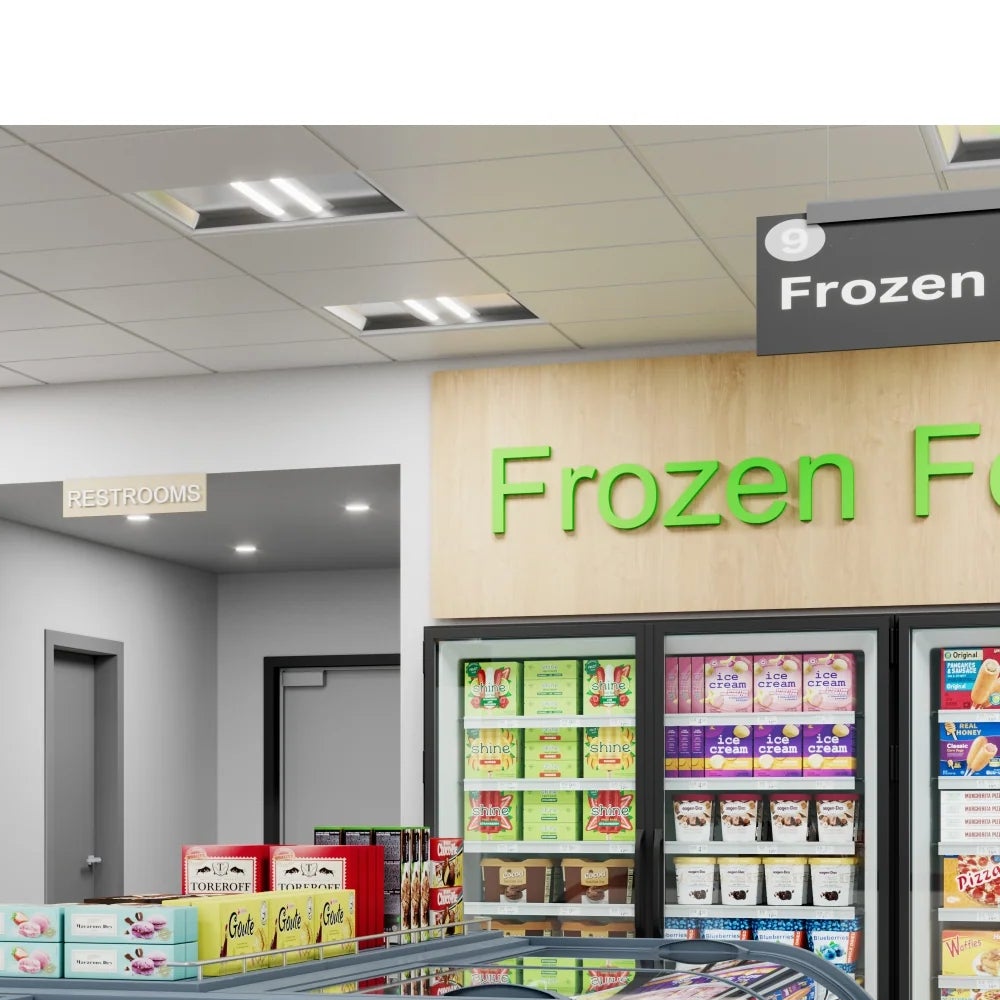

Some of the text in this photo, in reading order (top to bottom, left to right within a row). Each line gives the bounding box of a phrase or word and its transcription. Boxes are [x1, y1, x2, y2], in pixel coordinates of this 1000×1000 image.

[780, 226, 807, 254] 9
[780, 269, 985, 311] Frozen
[491, 422, 1000, 536] Frozen F
[67, 484, 201, 508] RESTROOMS
[716, 672, 739, 680] ice
[766, 672, 788, 680] ice
[815, 671, 838, 679] ice
[473, 682, 506, 693] shine
[591, 680, 625, 691] shine
[758, 680, 796, 688] cream
[807, 679, 846, 687] cream
[717, 735, 740, 745] ice
[766, 735, 790, 744] ice
[816, 734, 840, 744] ice
[471, 743, 510, 754] shine
[589, 742, 631, 753] shine
[709, 745, 748, 754] cream
[758, 745, 798, 753] cream
[808, 744, 848, 753] cream
[472, 804, 510, 816] shine
[591, 803, 629, 816] shine
[191, 882, 251, 891] TOREROFF
